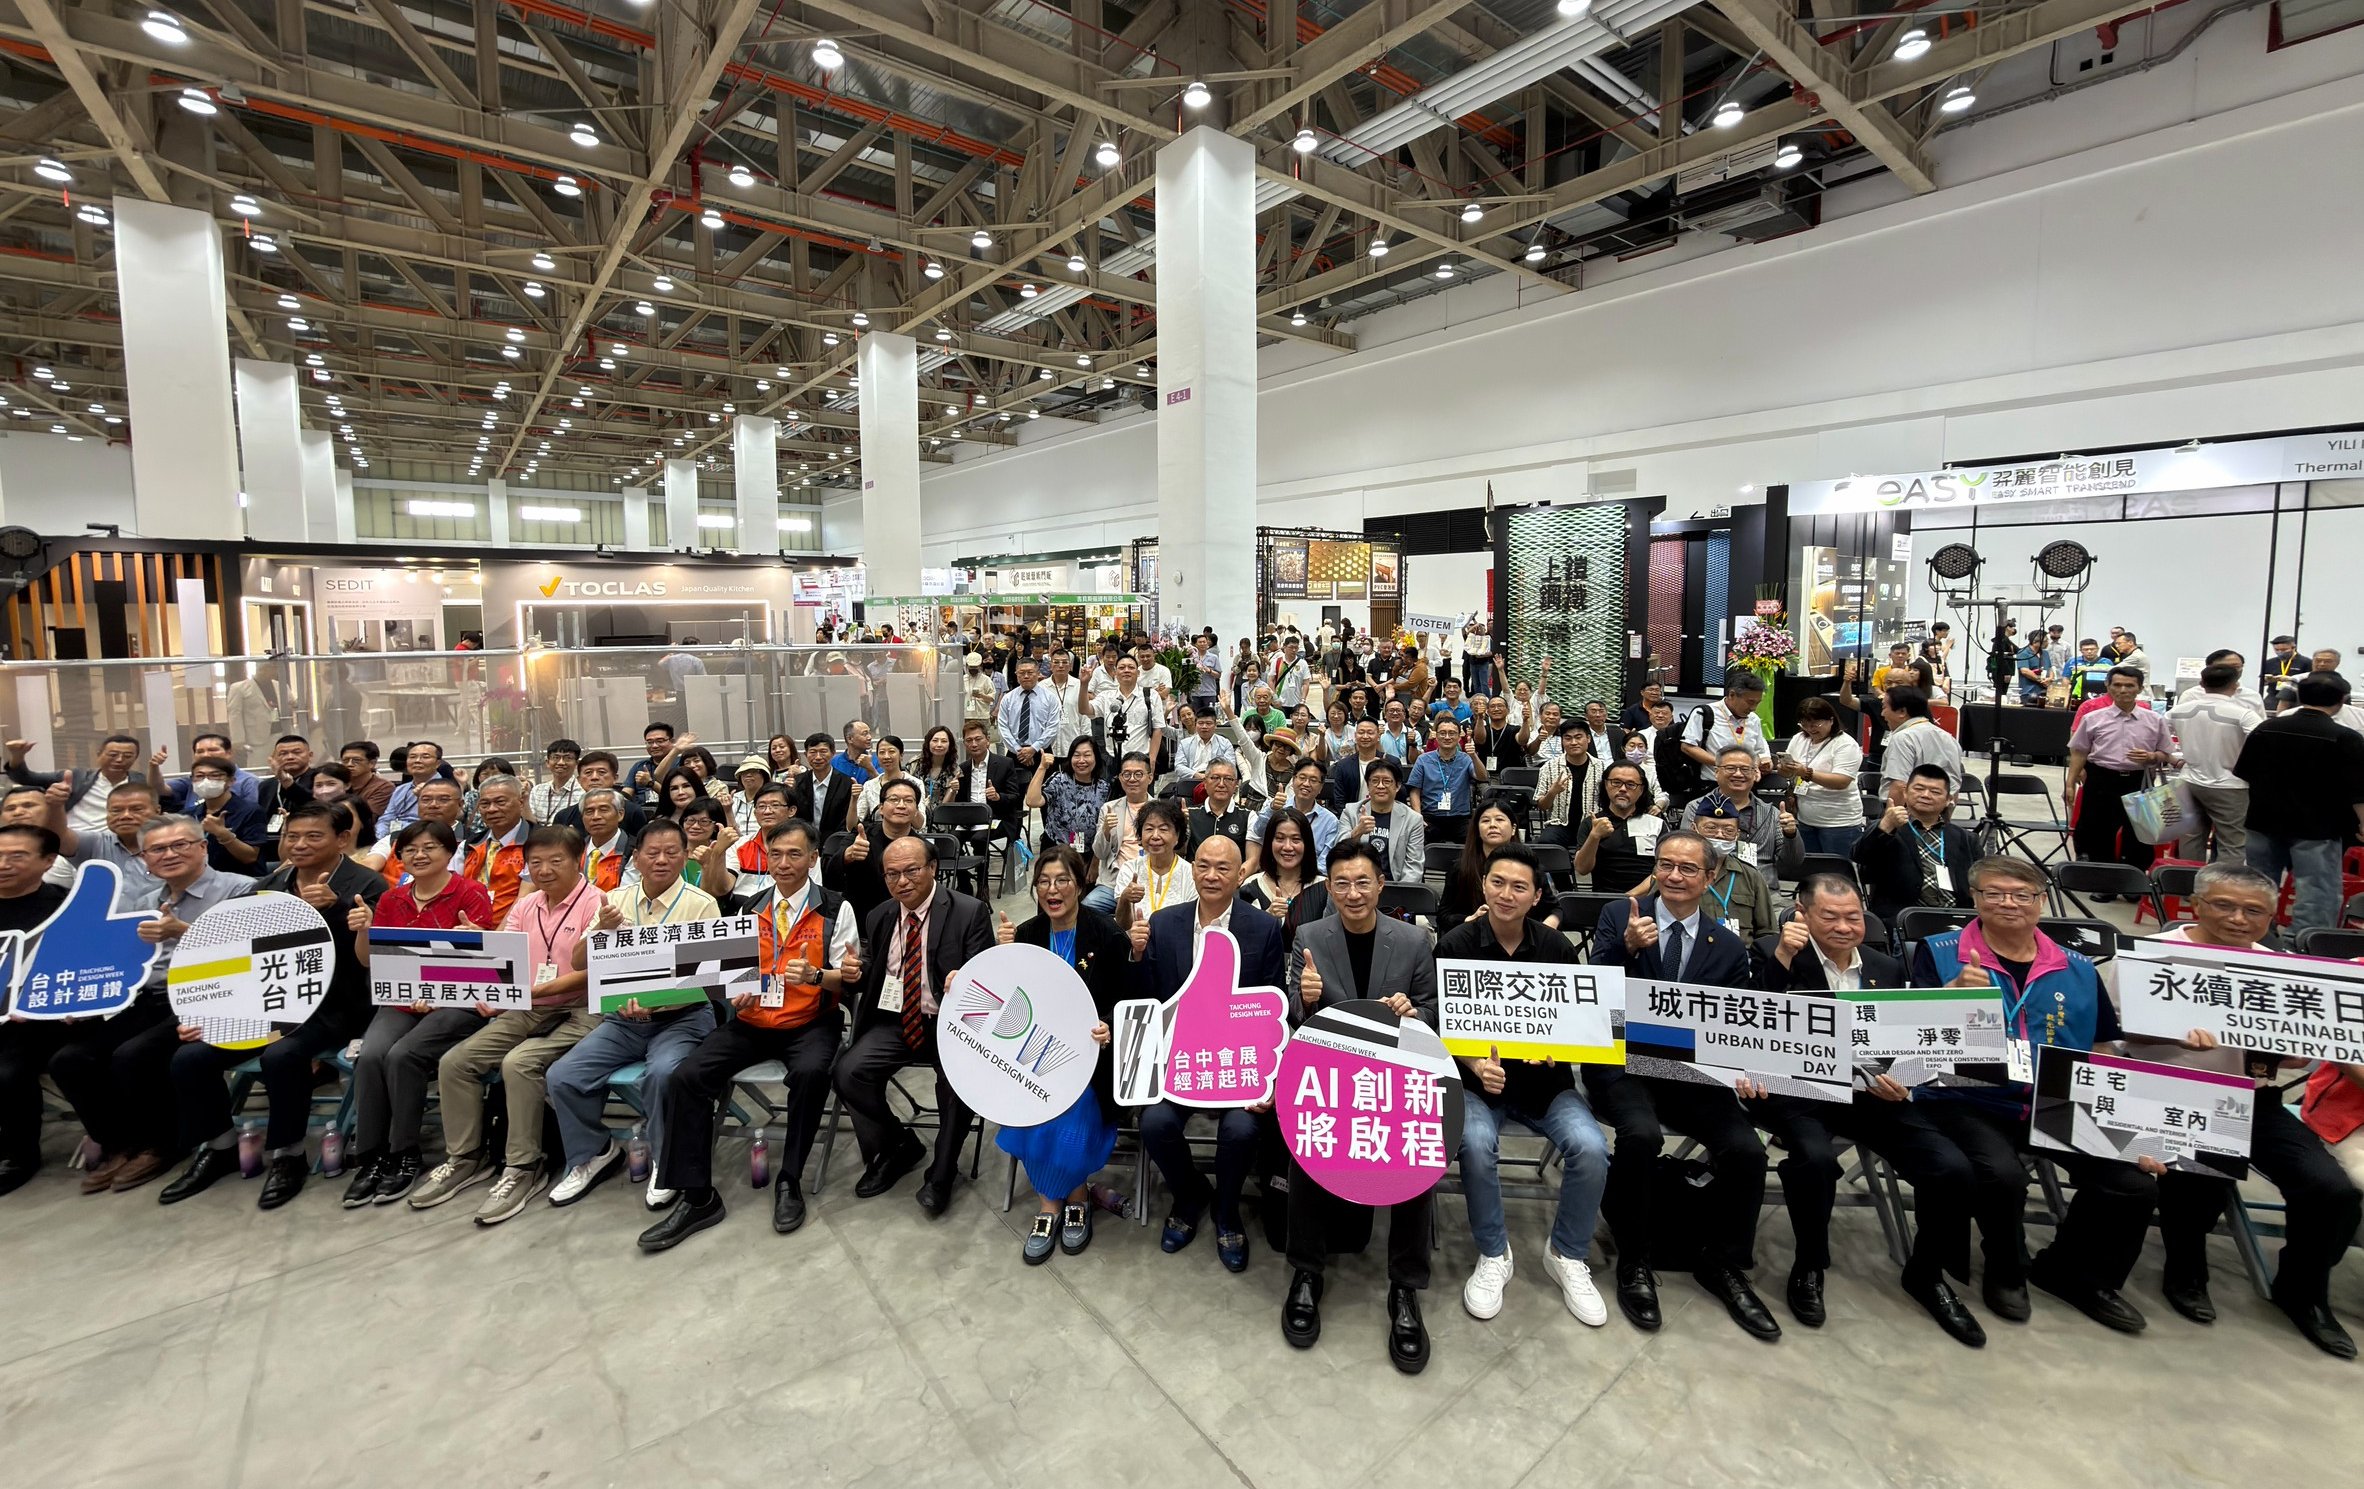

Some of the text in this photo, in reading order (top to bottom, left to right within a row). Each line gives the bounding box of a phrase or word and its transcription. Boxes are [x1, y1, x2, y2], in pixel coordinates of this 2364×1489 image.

[2327, 439, 2357, 451] YILI
[1992, 458, 2137, 488] 羿麗智能創見
[2294, 460, 2363, 474] Thermal
[2019, 486, 2060, 497] SMART
[1710, 508, 1729, 518] 出口
[326, 579, 374, 591] SEDIT
[564, 581, 755, 596] TOCLAS Japan Quality Kitchen
[1409, 617, 1451, 630] TOSTEM
[591, 917, 753, 951] 會展經濟惠台中
[79, 964, 115, 975] TAICHUNG
[260, 947, 324, 983] 光耀
[31, 969, 76, 991] 台中
[77, 970, 125, 982] DESIGN WEEK
[1442, 967, 1599, 1006] 國際交流日
[28, 980, 123, 1009] 設計週讚
[176, 982, 221, 996] TAICHUNG
[176, 989, 234, 1006] DESIGN WEEK
[262, 978, 323, 1013] 台中
[374, 981, 523, 1003] 明日宜居大台中
[2149, 967, 2364, 1024] 永續產業日
[1229, 1002, 1262, 1011] TAICHUNG
[1229, 1009, 1272, 1019] DESIGN WEEK
[1444, 1001, 1558, 1020] GLOBAL DESIGN
[1648, 985, 1837, 1038] 城市設計日
[1445, 1018, 1554, 1036] EXCHANGE DAY
[1851, 1027, 1962, 1047] 與 淨零
[1298, 1033, 1377, 1058] TAICHUNG DESIGN WEEK
[1705, 1031, 1837, 1059] URBAN DESIGN
[2220, 1031, 2327, 1058] INDUSTRY
[946, 1021, 1051, 1103] TAICHUNG DESIGN WEEK
[1173, 1045, 1258, 1070] 台中會展
[1173, 1067, 1260, 1092] 經濟起飛
[1803, 1061, 1837, 1077] DAY
[2074, 1065, 2127, 1092] 住宅
[2095, 1095, 2115, 1116] 與
[2163, 1106, 2207, 1131] 室內
[2107, 1119, 2187, 1138] RESIDENTIAL AND INTERIOR
[1295, 1111, 1447, 1169] 將啟程
[2164, 1138, 2188, 1147] DESIGN
[2193, 1143, 2241, 1156] CONSTRUCTION
